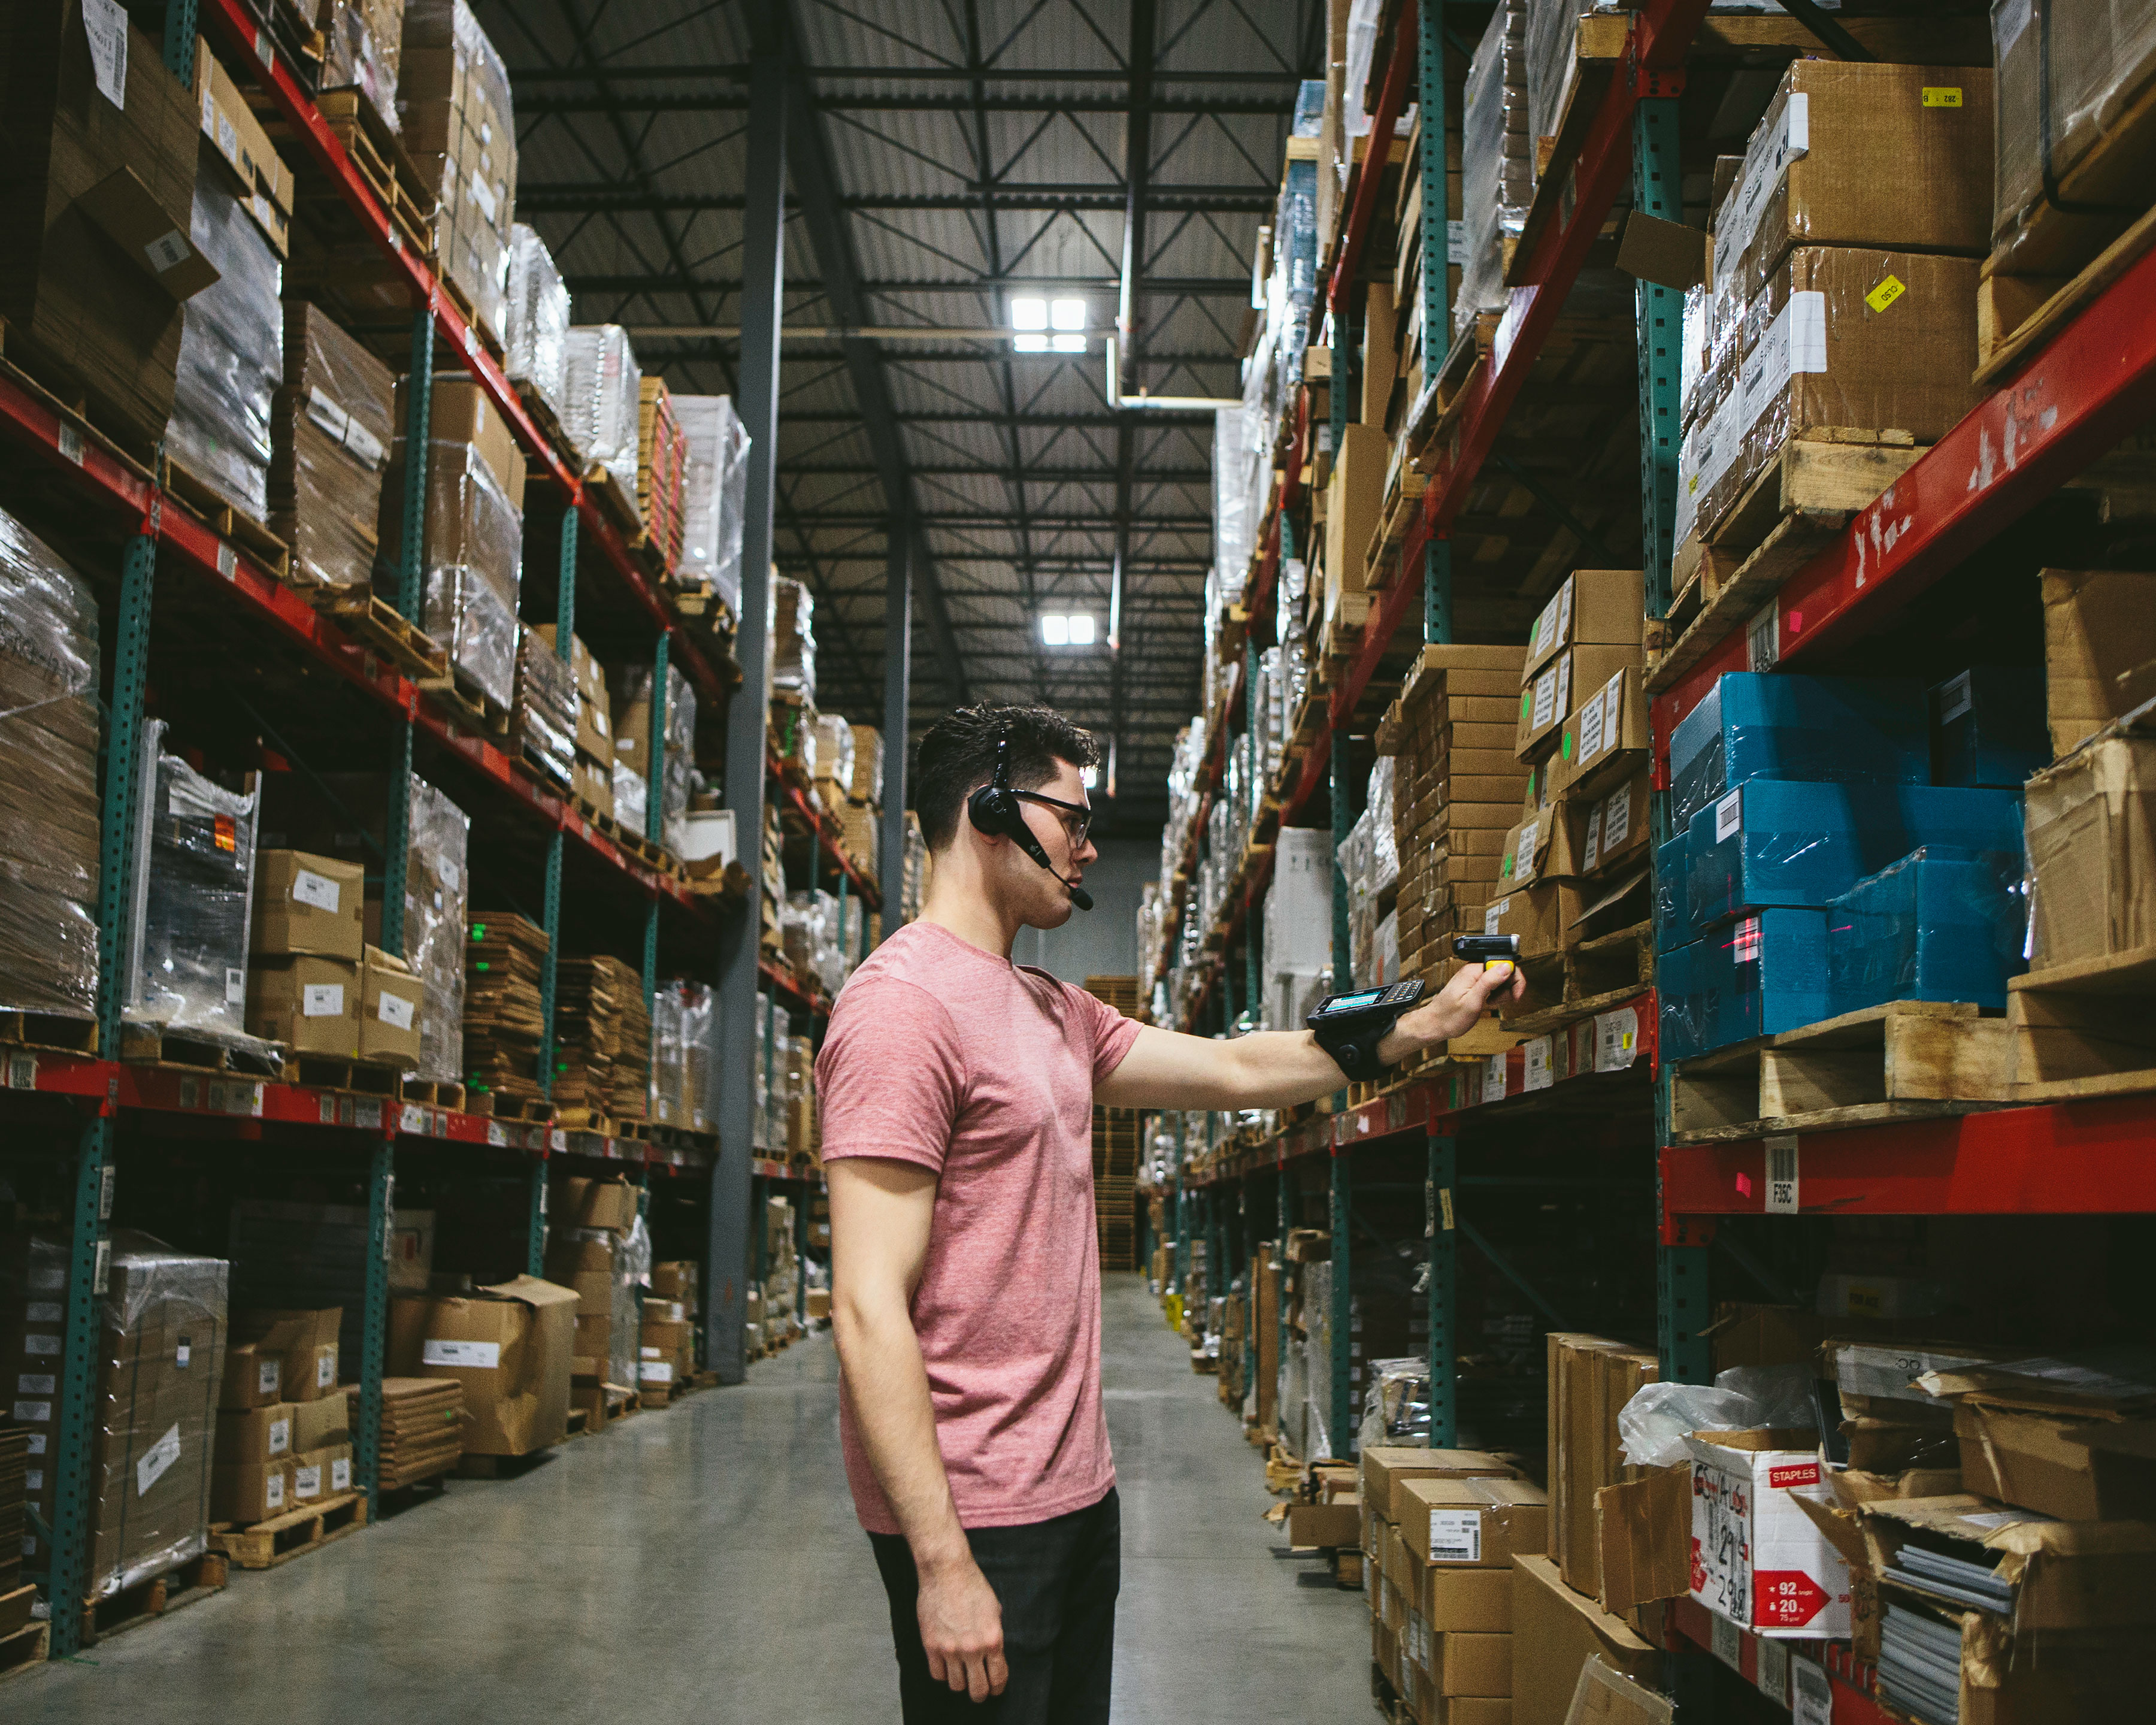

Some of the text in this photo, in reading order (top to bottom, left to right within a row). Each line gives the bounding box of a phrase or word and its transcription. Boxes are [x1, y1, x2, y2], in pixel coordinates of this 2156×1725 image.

[1881, 285, 1898, 301] CLSD
[1773, 1467, 1816, 1482] STAPLES
[1779, 1581, 1797, 1596] 92
[1779, 1599, 1797, 1612] 20
